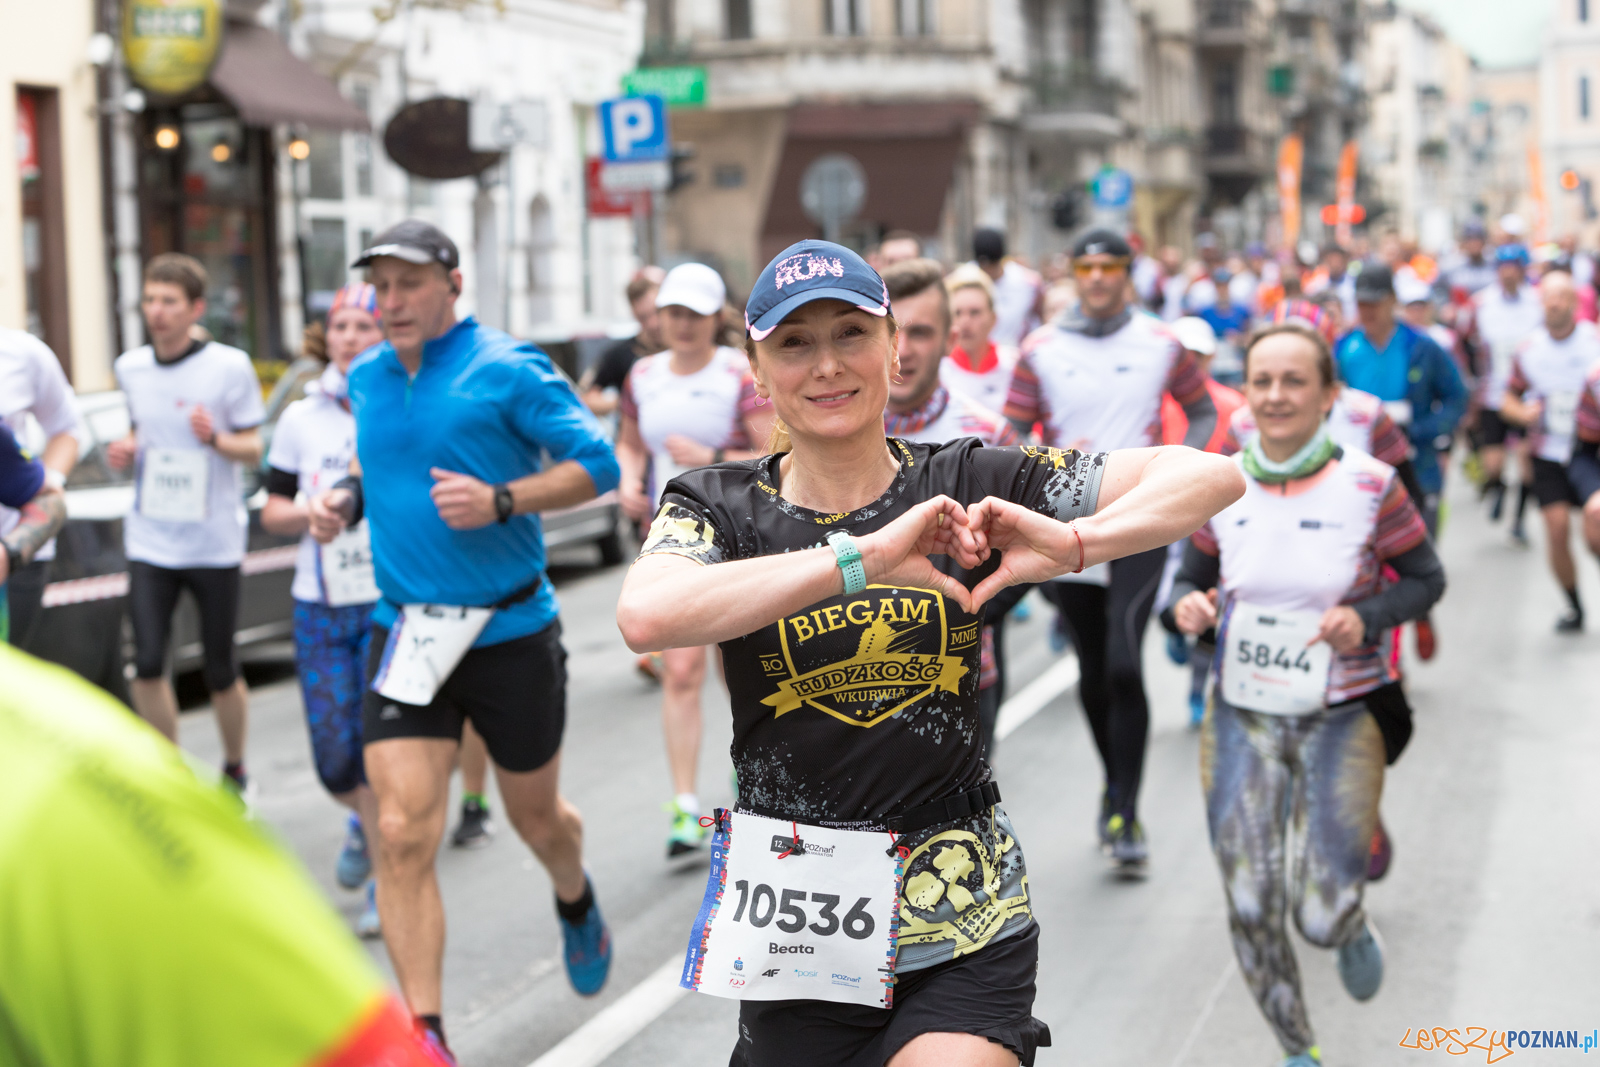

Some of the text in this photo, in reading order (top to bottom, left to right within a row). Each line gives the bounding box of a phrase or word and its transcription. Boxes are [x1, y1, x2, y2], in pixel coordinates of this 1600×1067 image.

[610, 100, 654, 154] P
[775, 257, 844, 290] RUN
[789, 598, 932, 642] BIEGAM
[951, 627, 978, 646] MNIE
[761, 658, 784, 672] BO
[1237, 639, 1311, 673] 5844
[833, 687, 907, 704] WKURWIA
[819, 819, 874, 828] compressport
[732, 879, 876, 940] 10536
[768, 942, 815, 955] Beata
